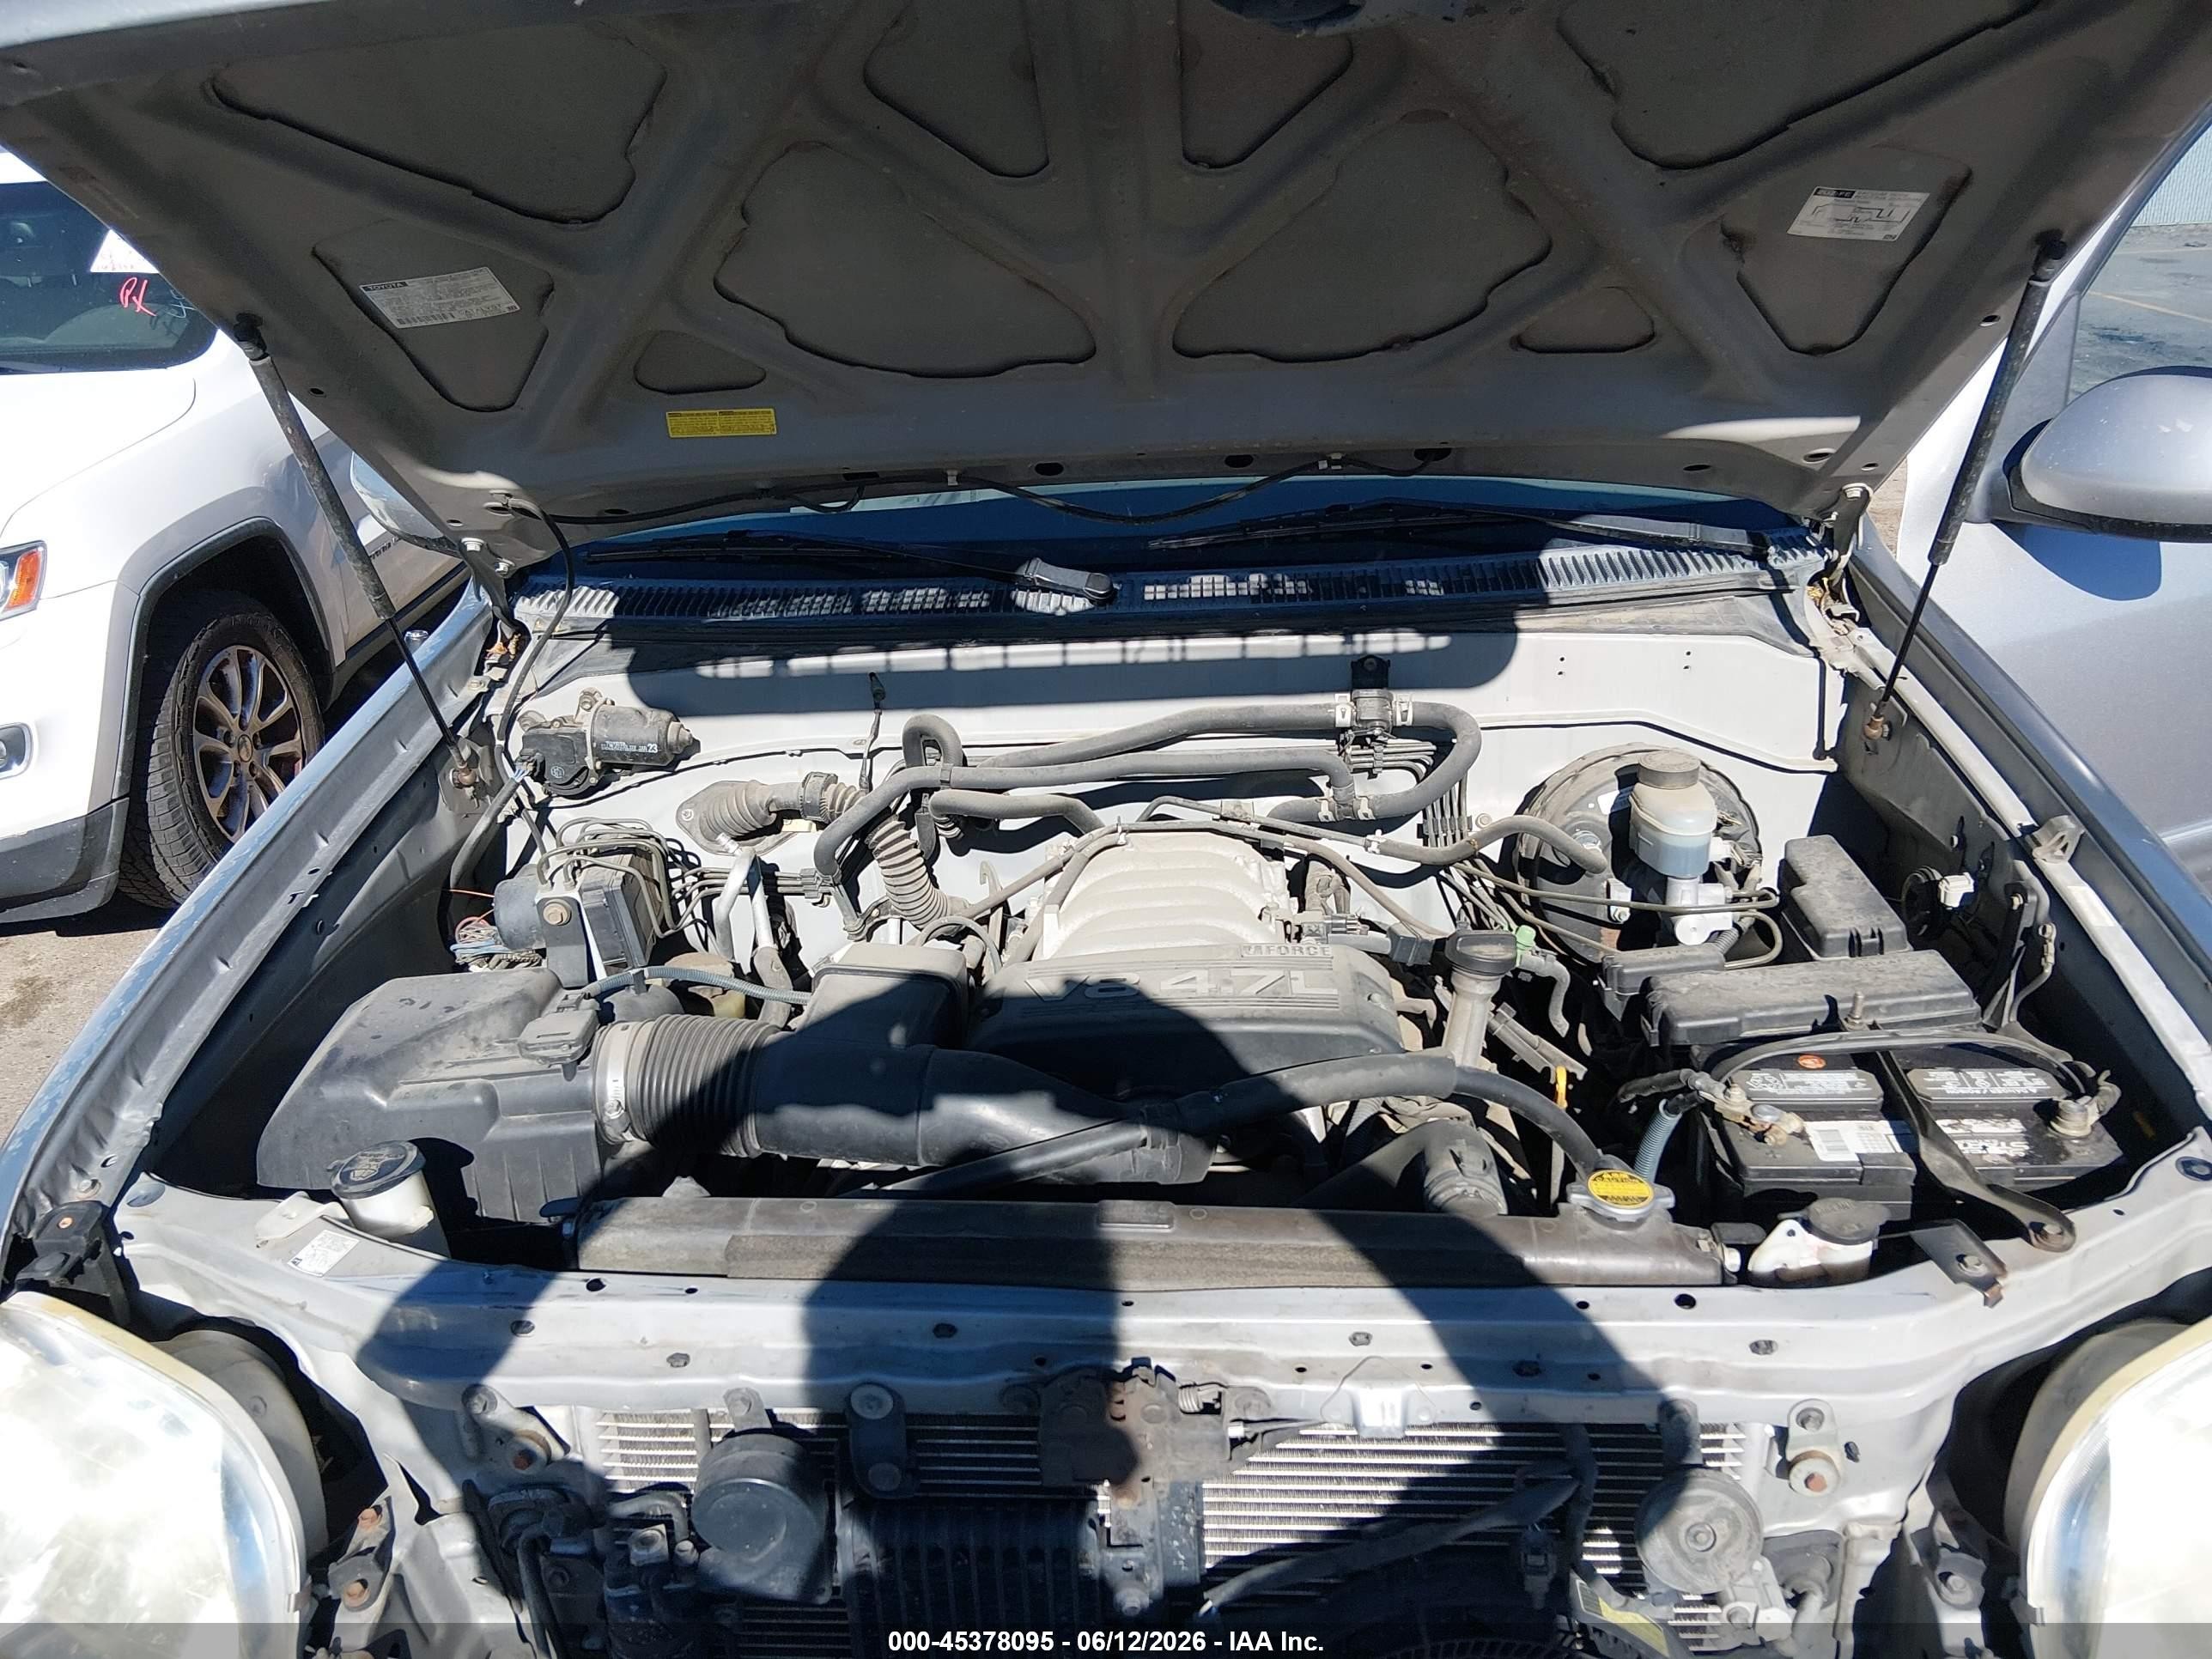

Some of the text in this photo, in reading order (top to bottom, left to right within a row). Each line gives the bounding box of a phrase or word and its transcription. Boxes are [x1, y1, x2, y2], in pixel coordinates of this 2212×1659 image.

[366, 283, 404, 291] TOYOTA
[647, 743, 659, 754] 23
[1024, 969, 1338, 1001] V8 4.7L
